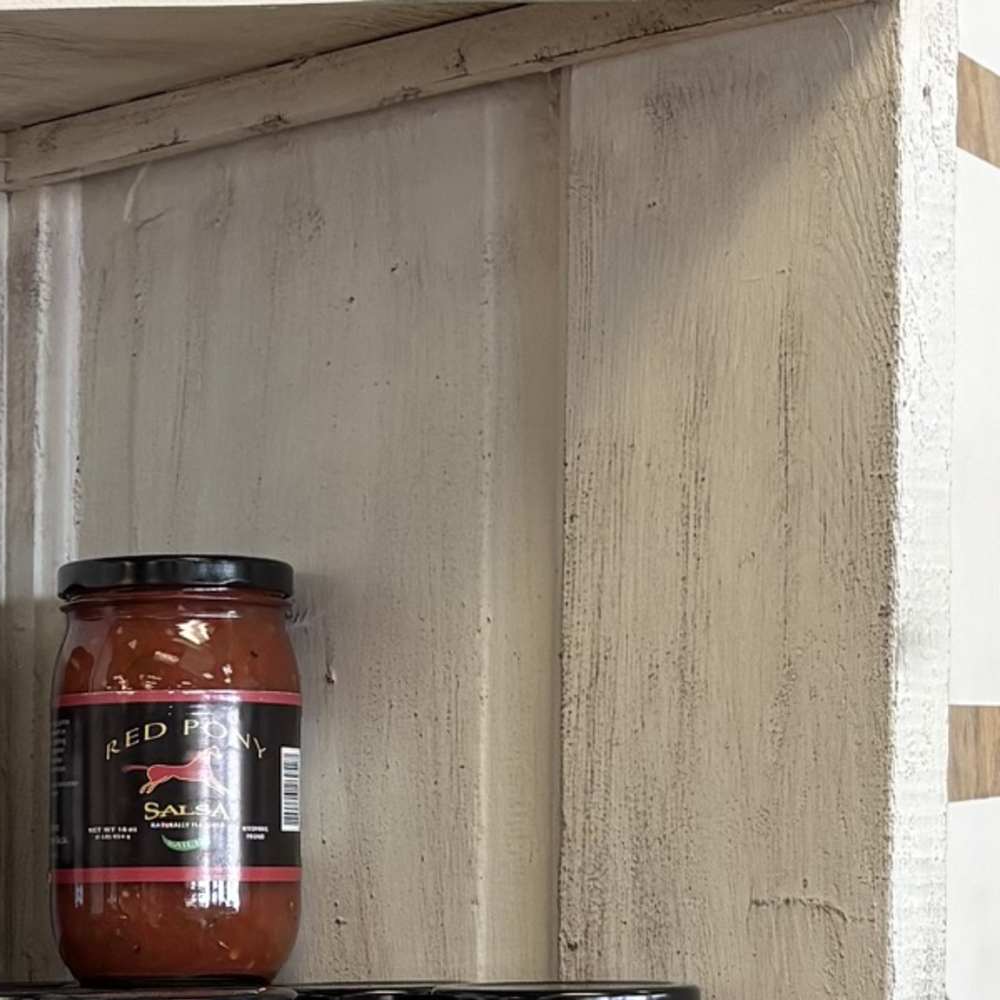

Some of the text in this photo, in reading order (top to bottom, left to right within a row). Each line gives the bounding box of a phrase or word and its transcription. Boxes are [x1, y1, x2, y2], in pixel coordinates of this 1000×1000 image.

[105, 721, 168, 760] RED
[184, 719, 267, 759] PONY
[143, 802, 230, 822] SALSA
